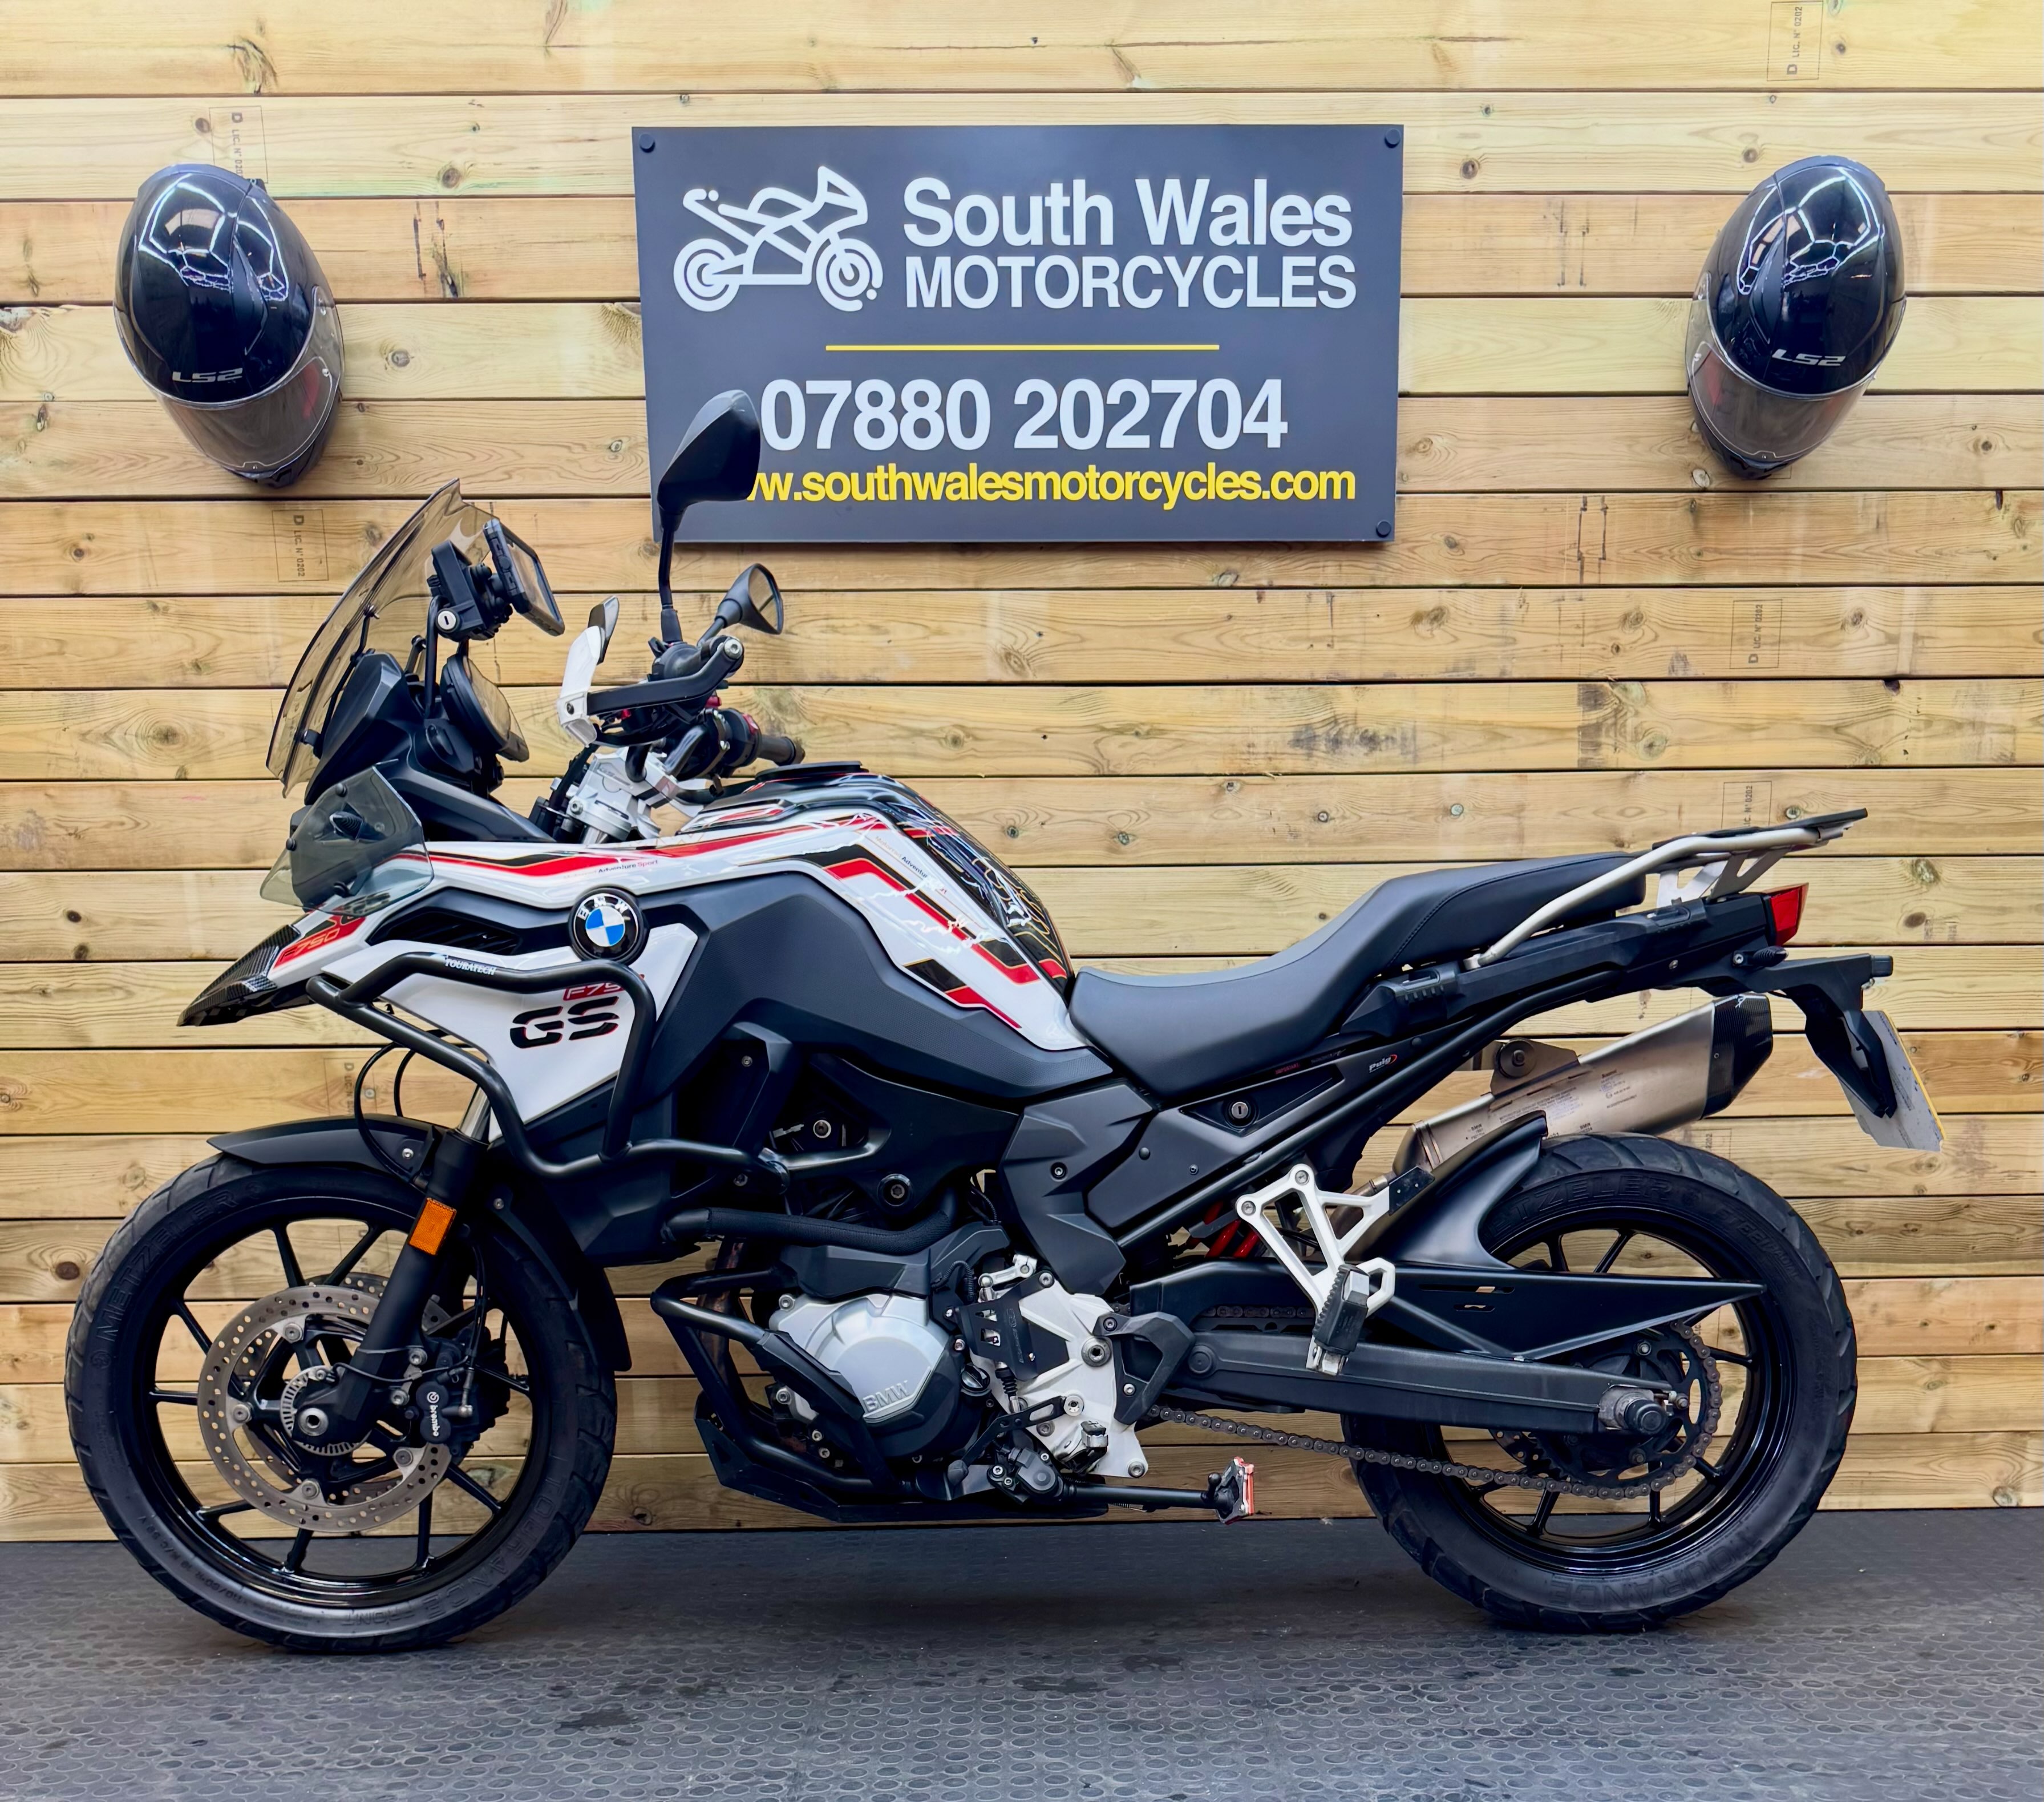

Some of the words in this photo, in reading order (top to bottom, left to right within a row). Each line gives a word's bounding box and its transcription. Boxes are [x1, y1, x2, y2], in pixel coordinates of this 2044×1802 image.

[1794, 7, 1803, 26] 0202
[234, 160, 244, 177] 020
[904, 177, 1114, 247] South
[1135, 179, 1353, 247] Wales
[906, 256, 1357, 309] MOTORCYCLES
[1772, 349, 1846, 366] LS2
[172, 367, 243, 382] LS2
[761, 379, 991, 451] 07880
[1014, 378, 1288, 450] 202704
[747, 462, 1356, 510] w.southwalesmotorcycles.com
[297, 558, 305, 577] 0202
[1745, 786, 1753, 802] 0202
[598, 863, 636, 873] Adventure
[637, 859, 658, 868] Sport
[901, 856, 928, 878] Adventur
[577, 896, 629, 920] BMW
[280, 927, 341, 962] F750
[445, 958, 497, 975] TOURATECH
[567, 982, 622, 999] F75
[510, 996, 620, 1049] GS
[1369, 1057, 1391, 1072] Puig
[96, 1190, 240, 1342] METZELER
[863, 1380, 908, 1413] BMW
[430, 1405, 440, 1436] brembo
[423, 1477, 565, 1619] TOURANCE
[1549, 1530, 1764, 1611] TOURANCE
